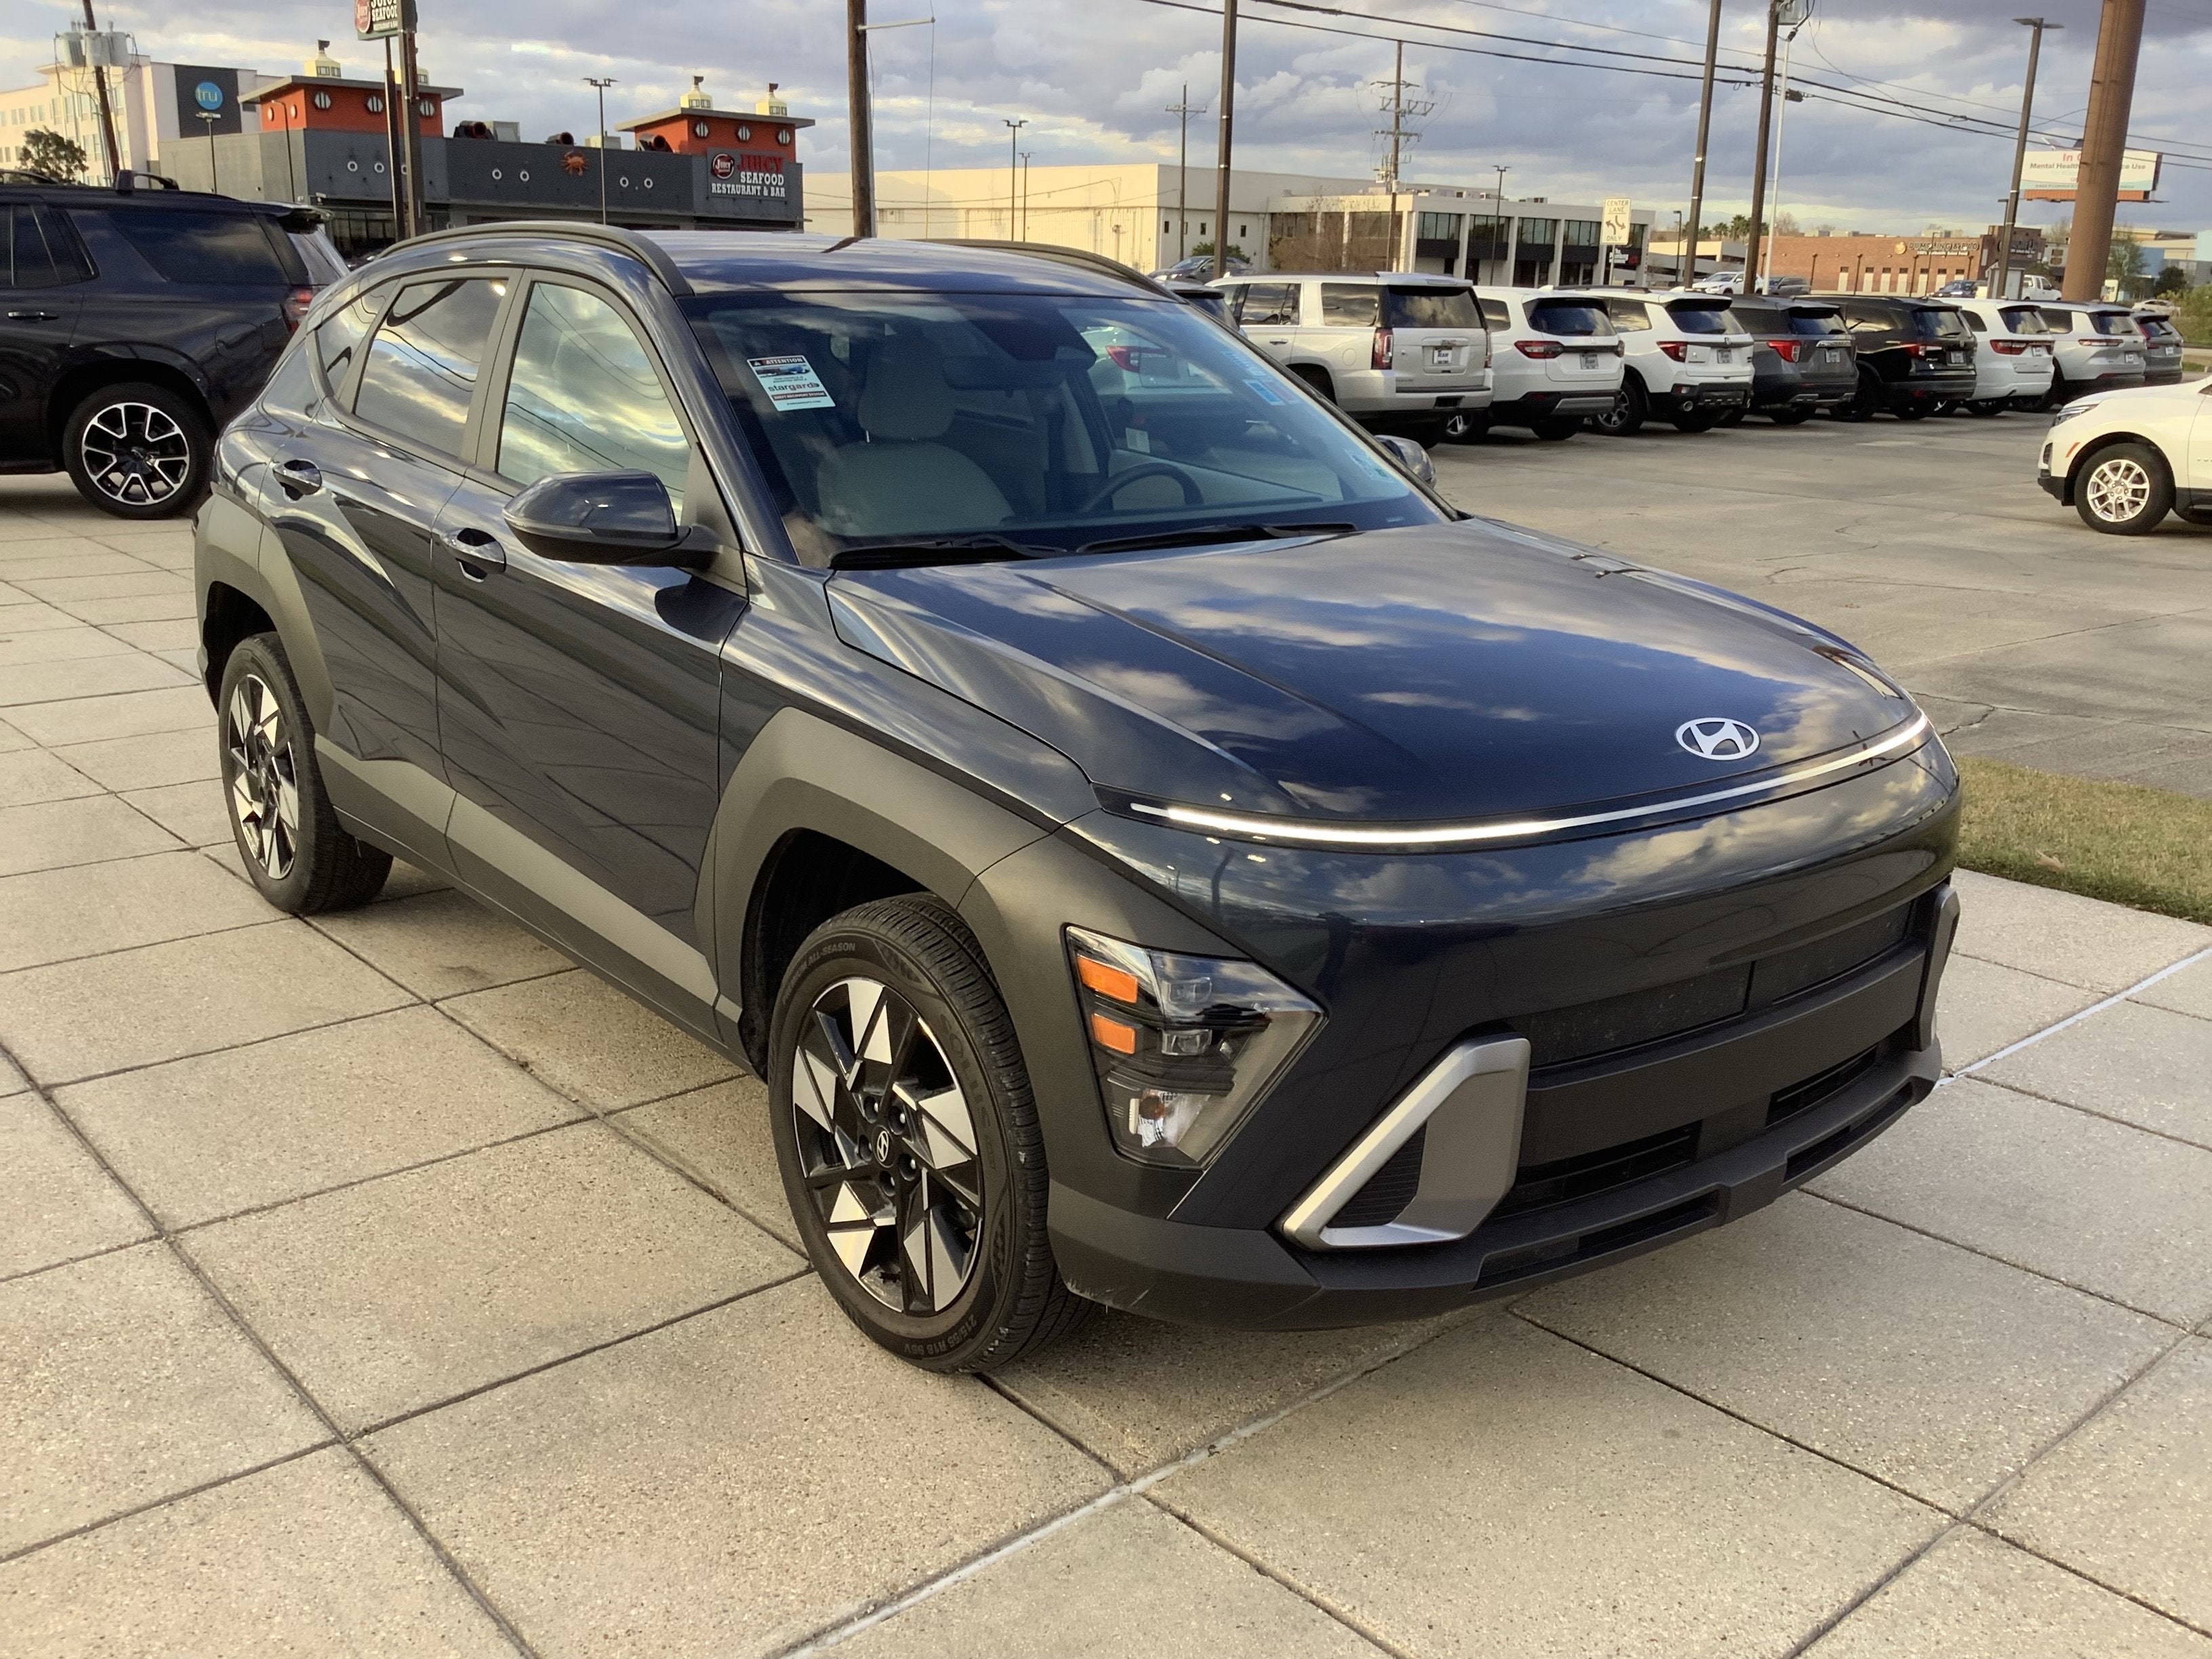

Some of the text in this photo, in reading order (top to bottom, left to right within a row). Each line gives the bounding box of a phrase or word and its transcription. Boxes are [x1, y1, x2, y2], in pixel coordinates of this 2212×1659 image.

[196, 85, 218, 102] tru
[737, 154, 784, 173] JUICY
[740, 171, 784, 186] SEAFOOD
[711, 182, 785, 198] RESTAURANT & BAR
[766, 357, 803, 365] ATTENTION
[768, 382, 815, 392] stargard
[807, 942, 856, 966] ALL-SEASON
